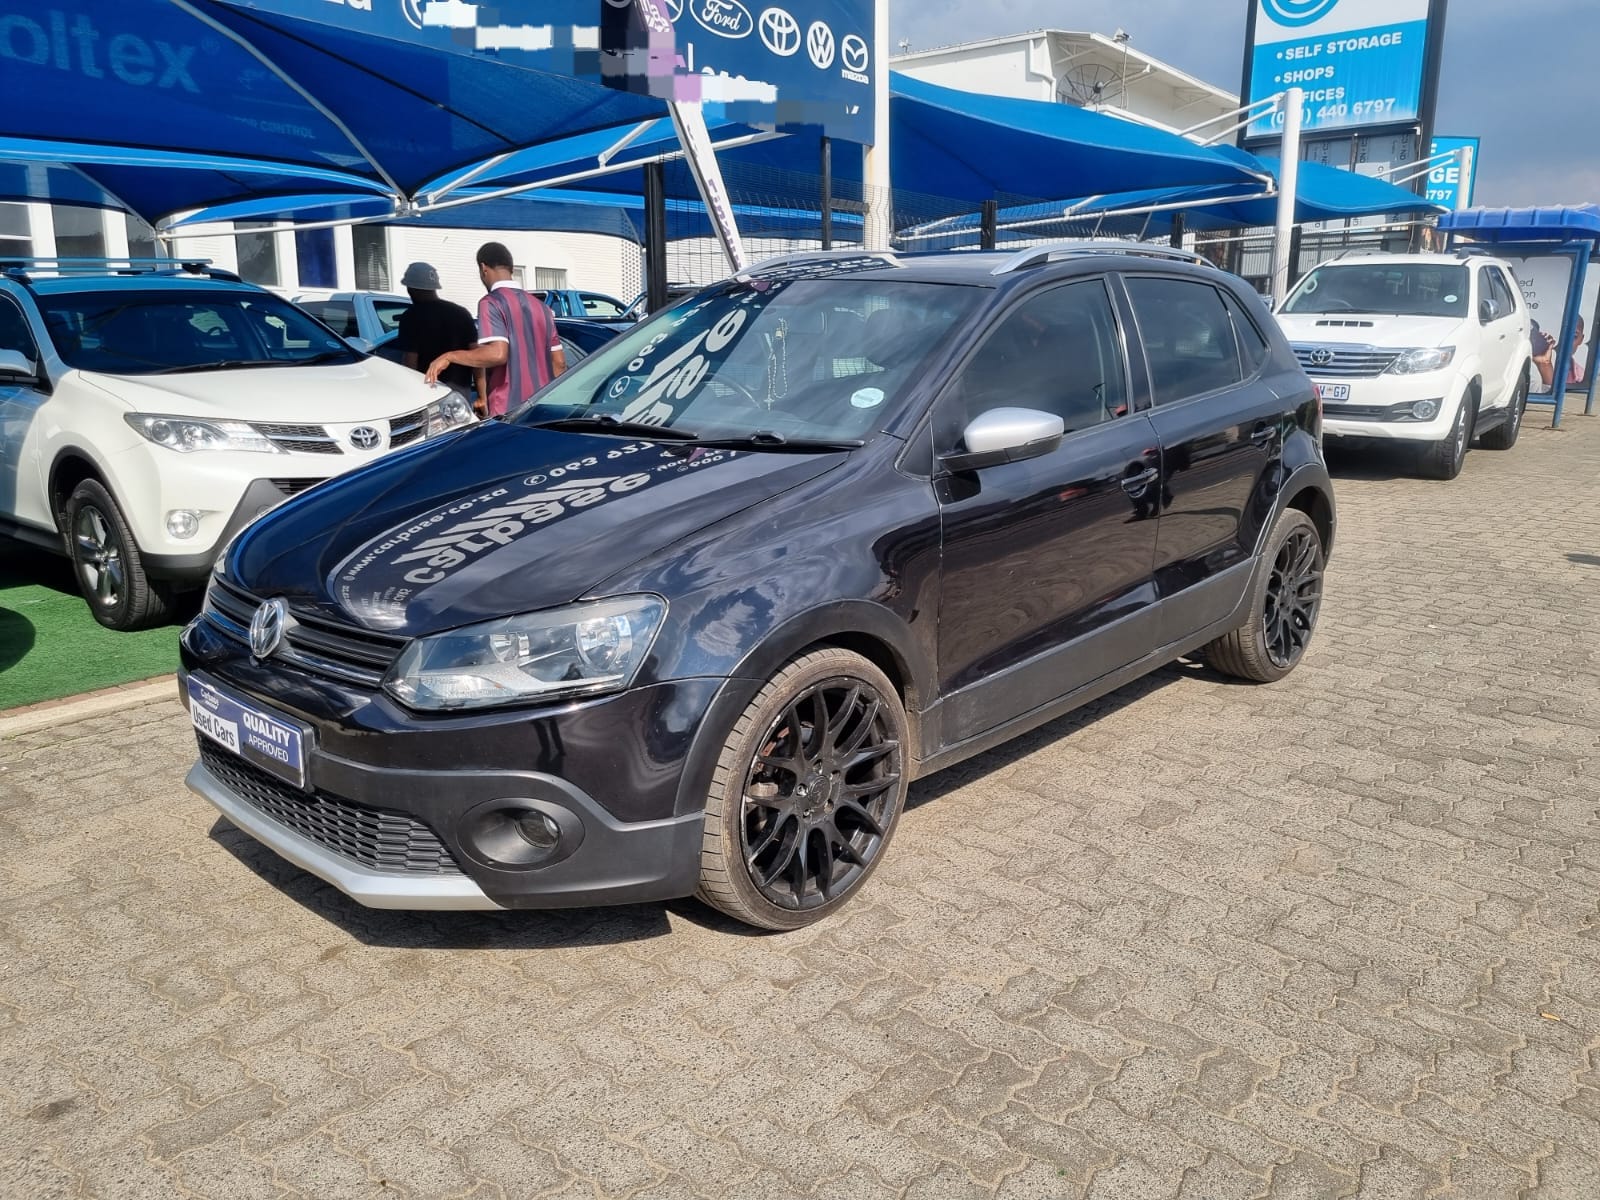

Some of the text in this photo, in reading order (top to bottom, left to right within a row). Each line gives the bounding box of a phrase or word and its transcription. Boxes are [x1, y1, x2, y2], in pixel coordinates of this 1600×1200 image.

[701, 0, 742, 31] Ford
[1285, 32, 1403, 60] SELF STORAGE
[1283, 66, 1335, 83] SHOPS
[1317, 104, 1347, 119] 440
[1352, 98, 1396, 115] 6797
[1427, 167, 1460, 184] GE
[1333, 386, 1347, 398] GP
[193, 704, 235, 747] Used Cars
[243, 712, 290, 747] QUALITY
[248, 734, 288, 762] APPROVED
